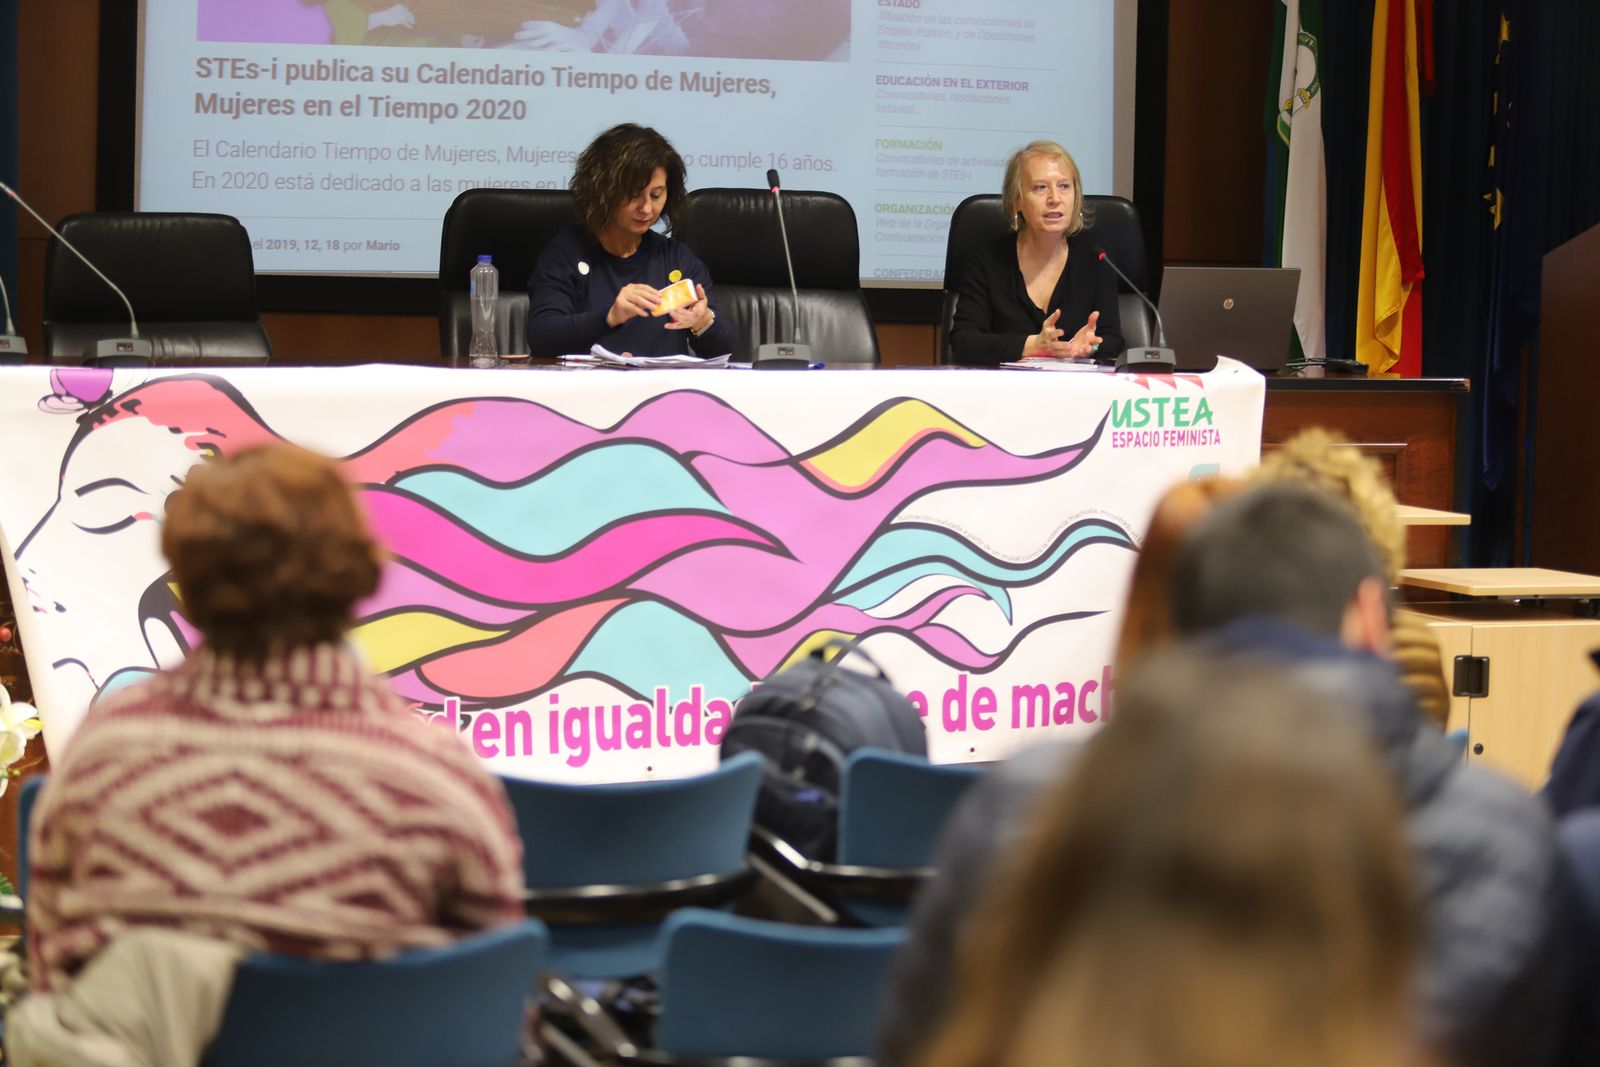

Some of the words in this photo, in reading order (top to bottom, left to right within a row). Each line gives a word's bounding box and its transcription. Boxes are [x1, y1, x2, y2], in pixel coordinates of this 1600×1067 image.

[877, 0, 921, 9] ESTADO
[924, 14, 937, 24] de
[195, 57, 278, 80] STEs-i
[285, 59, 374, 86] publica
[381, 65, 410, 84] su
[416, 62, 545, 87] Calendario
[552, 66, 638, 94] Tiempo
[645, 70, 673, 91] de
[679, 71, 777, 98] Mujeres,
[875, 74, 940, 88] EDUCACIÓN
[943, 77, 959, 88] EN
[960, 78, 974, 89] EL
[976, 79, 1030, 92] EXTERIOR
[194, 92, 295, 119] Mujeres
[303, 99, 332, 117] en
[339, 94, 361, 117] el
[368, 96, 459, 124] Tiempo
[466, 99, 527, 120] 2020
[874, 137, 943, 151] FORMACIÓN
[193, 138, 209, 158] El
[215, 140, 316, 160] Calendario
[321, 142, 392, 165] Tiempo
[396, 142, 419, 161] de
[424, 144, 501, 166] Mujeres,
[506, 144, 578, 168] Mujeres
[698, 150, 762, 172] cumple
[768, 152, 788, 170] 16
[792, 154, 838, 172] años.
[960, 157, 1006, 168] actividad
[191, 170, 215, 190] En
[221, 172, 270, 190] 2020
[274, 170, 315, 191] está
[320, 172, 405, 192] dedicado
[410, 179, 422, 193] a
[426, 174, 453, 193] las
[252, 238, 263, 250] el
[266, 238, 300, 252] 2019,
[304, 239, 322, 253] 12,
[326, 240, 340, 250] 18
[343, 241, 362, 254] por
[366, 239, 400, 252] Mario
[1111, 396, 1214, 428] USTEA
[1112, 430, 1160, 448] ESPACIO
[1162, 429, 1221, 447] FEMINISTA
[472, 709, 533, 759] en
[550, 684, 762, 768] igualda
[942, 674, 998, 732] de
